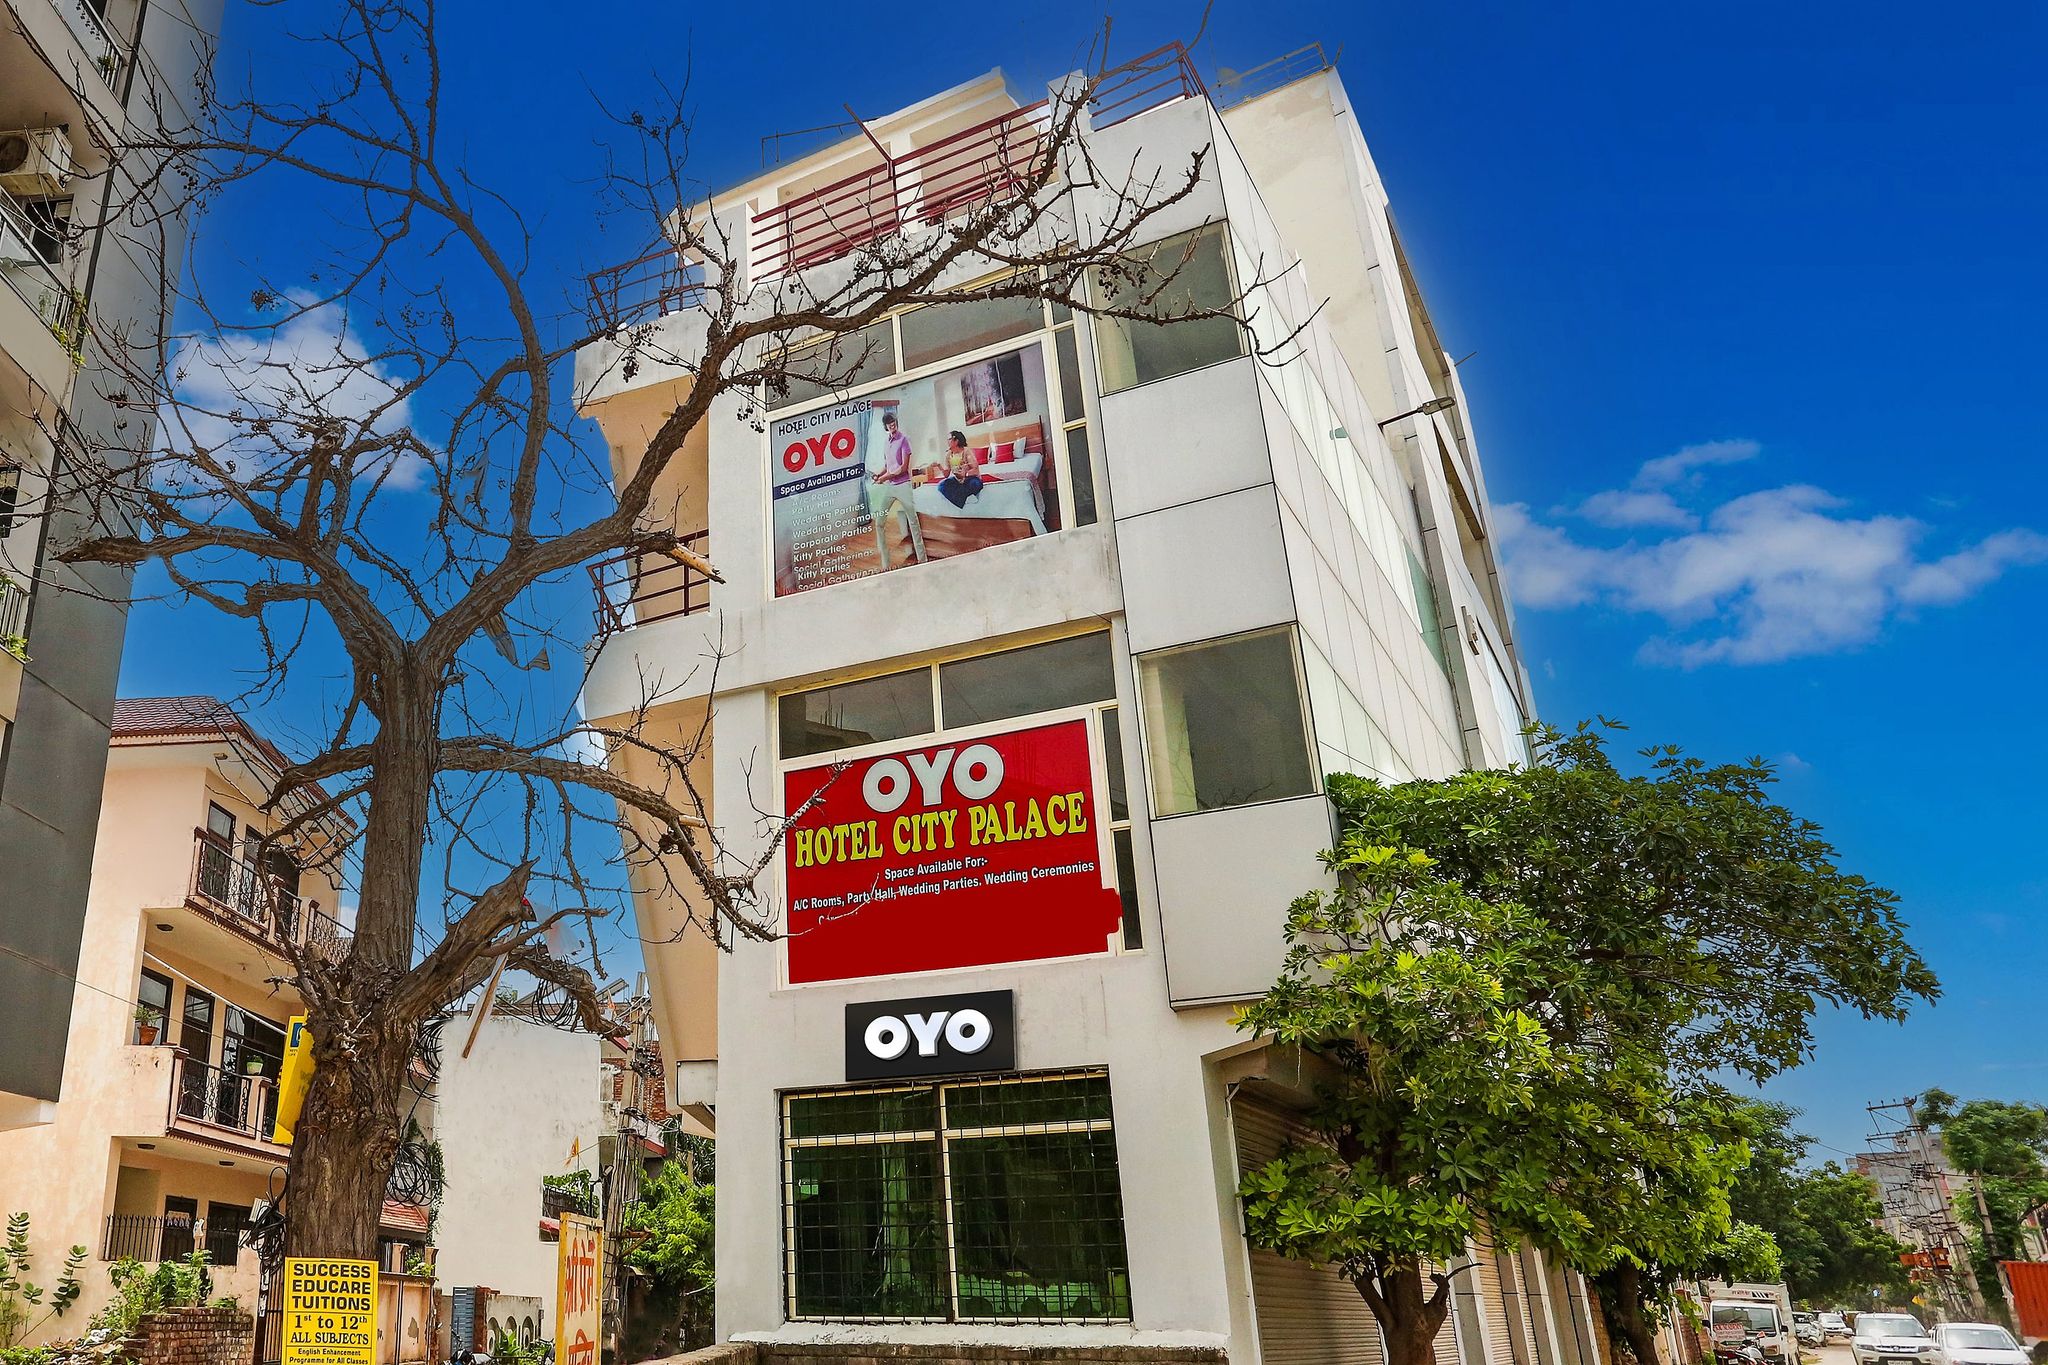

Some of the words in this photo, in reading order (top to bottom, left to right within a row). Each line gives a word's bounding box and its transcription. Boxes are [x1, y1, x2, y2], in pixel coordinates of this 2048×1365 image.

[778, 419, 807, 436] HOTEL
[810, 412, 830, 427] CITY
[834, 399, 871, 420] PALACE
[783, 428, 856, 473] OYO
[780, 482, 805, 495] Space
[812, 488, 841, 500] Rooms
[817, 499, 834, 507] Hall
[793, 512, 832, 527] Wedding
[834, 503, 865, 516] Parties
[793, 524, 832, 538] Wedding
[834, 509, 889, 528] Ceremonies
[793, 535, 839, 550] Corporate
[841, 525, 872, 538] Parties
[793, 551, 813, 563] Kitty
[815, 543, 846, 557] Parties
[794, 559, 821, 573] Social
[798, 569, 818, 581] Kitty
[820, 561, 851, 575] Parties
[798, 577, 826, 591] Social
[863, 744, 1004, 813] OYO
[795, 820, 883, 868] HOTEL
[893, 809, 958, 855] CITY
[968, 791, 1087, 846] PALACE
[884, 867, 914, 881] Space
[917, 858, 962, 875] Available
[793, 898, 809, 911] A/C
[811, 896, 845, 908] Rooms,
[847, 891, 871, 904] Party
[898, 882, 940, 896] Wedding
[984, 870, 1029, 885] Wedding
[1031, 861, 1095, 879] Ceremonies
[864, 1008, 993, 1061] OYO
[293, 1263, 371, 1278] SUCCESS
[292, 1280, 371, 1294] EDUCARE
[292, 1296, 371, 1311] TUITIONS
[295, 1315, 312, 1328] 1st
[317, 1315, 334, 1328] to
[341, 1315, 368, 1330] 12th
[290, 1332, 312, 1343] ALL
[315, 1332, 369, 1345] SUBJECTS
[289, 1356, 324, 1364] Programme
[322, 1348, 361, 1356] Enhancement
